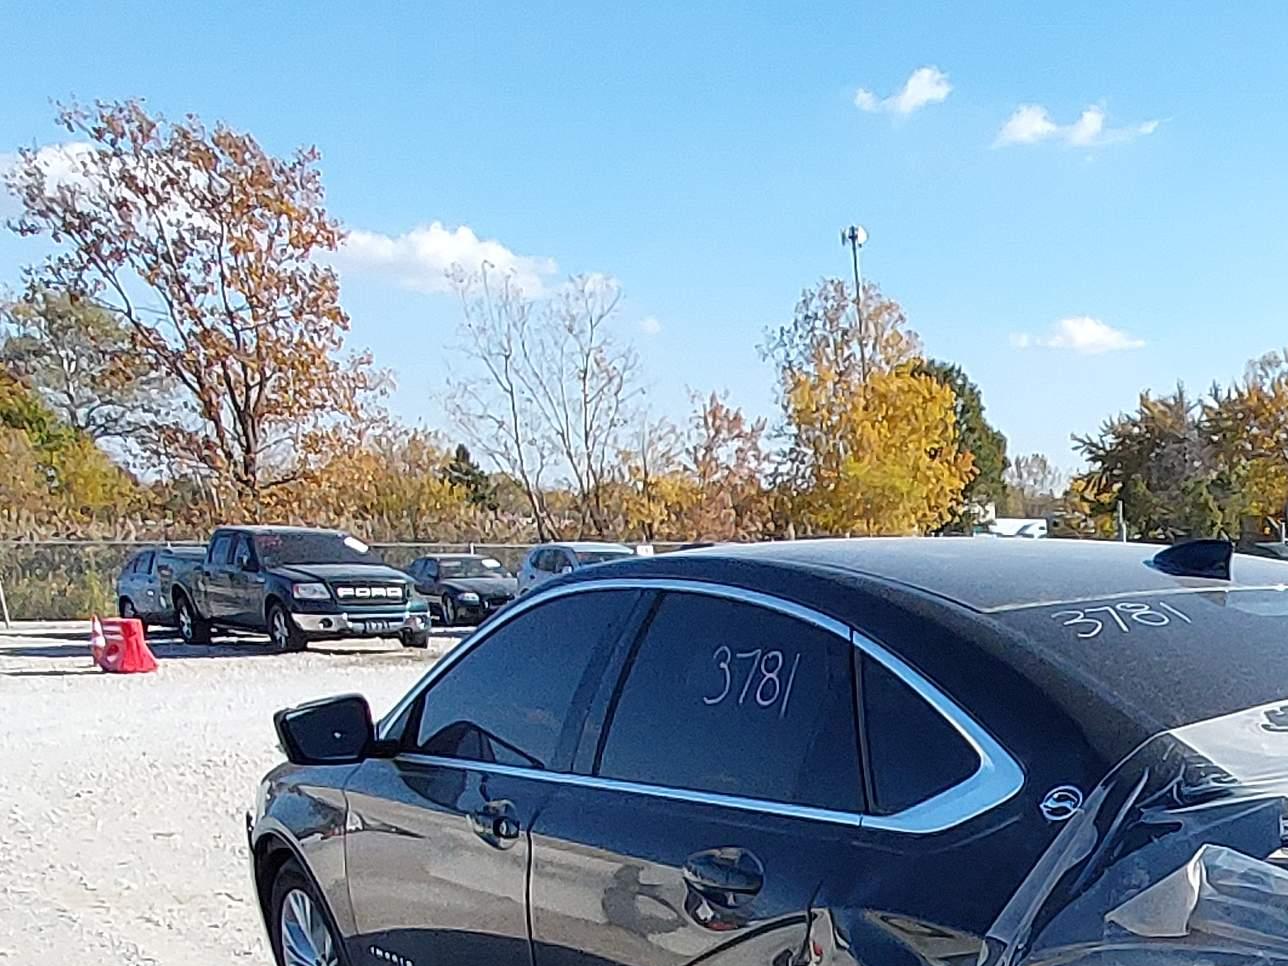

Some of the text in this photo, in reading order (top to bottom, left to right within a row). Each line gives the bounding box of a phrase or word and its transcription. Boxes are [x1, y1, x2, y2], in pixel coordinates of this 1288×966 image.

[336, 586, 403, 599] FORD
[1050, 601, 1192, 638] 3781
[703, 645, 801, 718] 3781
